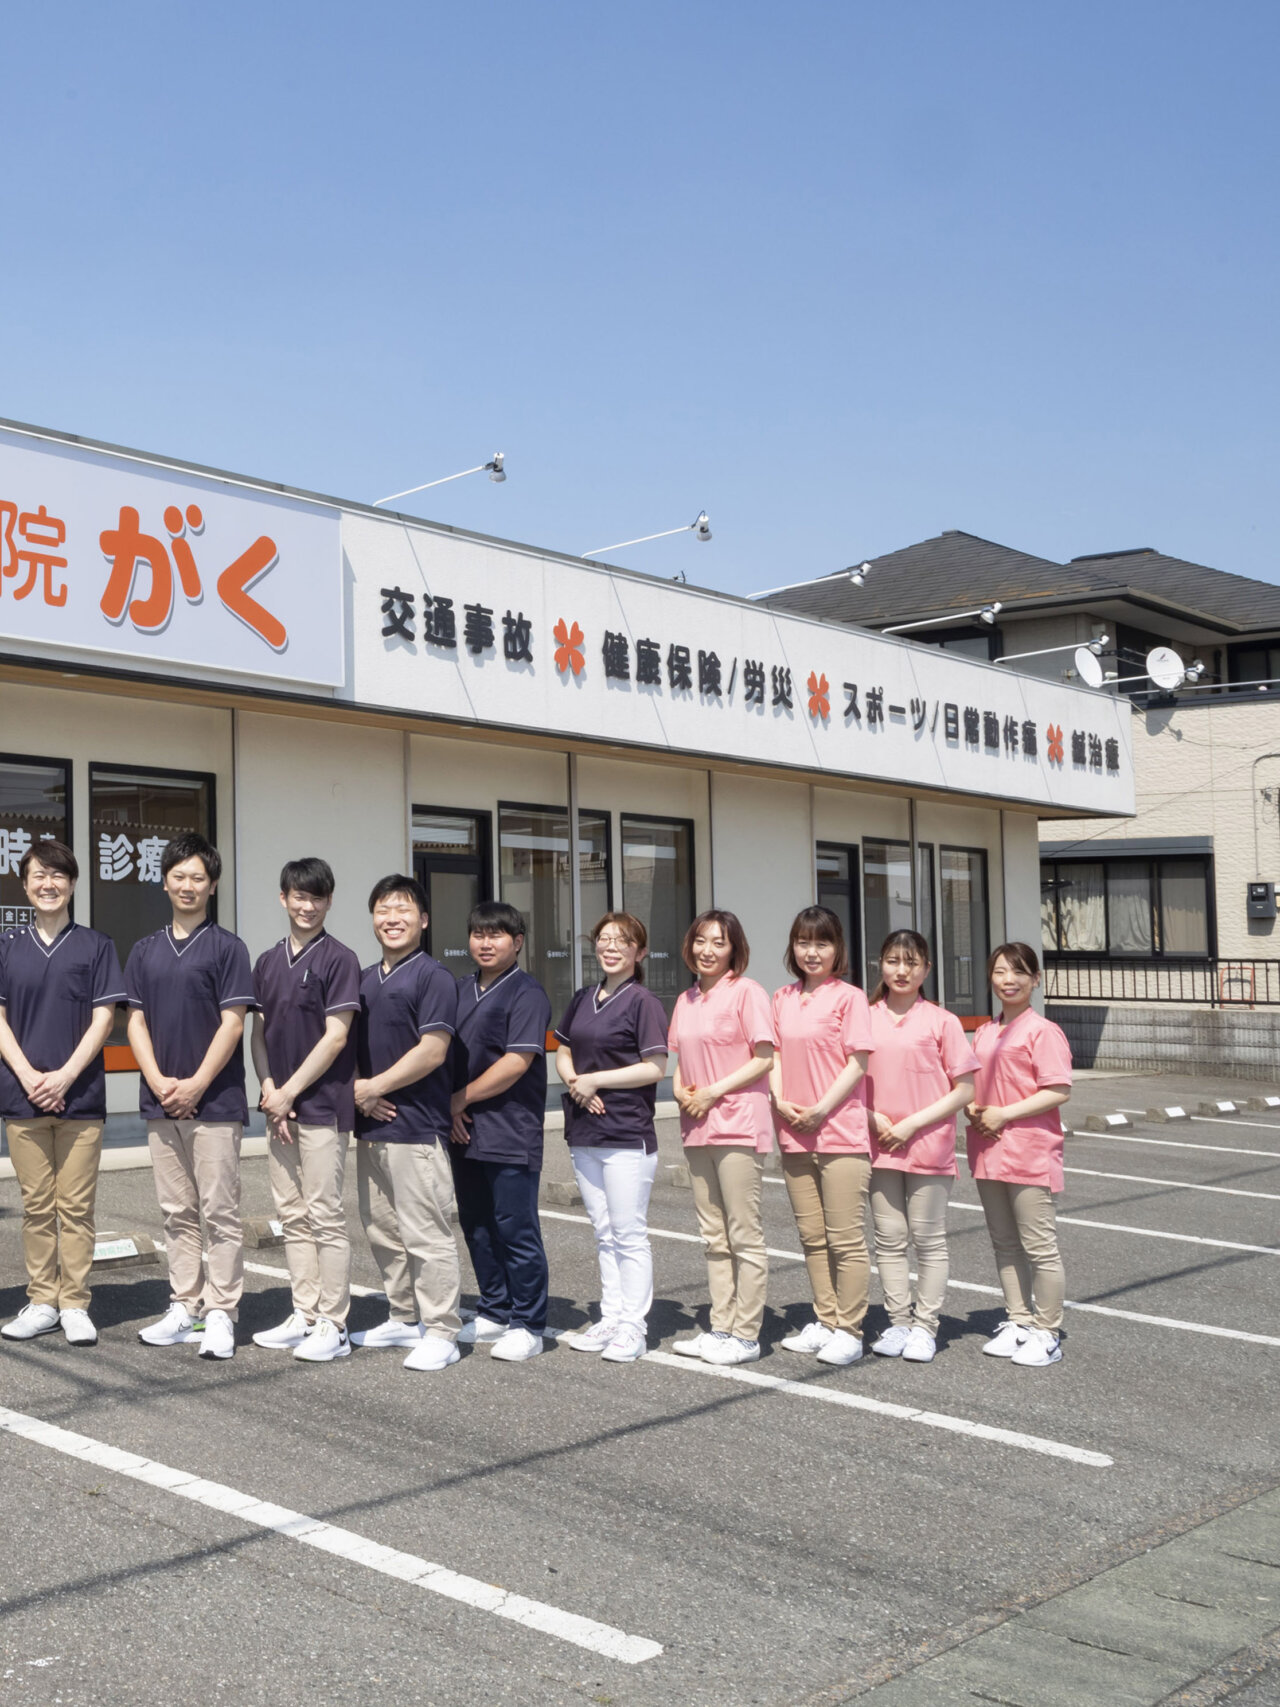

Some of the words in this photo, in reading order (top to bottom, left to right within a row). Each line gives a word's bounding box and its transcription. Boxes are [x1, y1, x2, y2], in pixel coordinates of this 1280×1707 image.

[99, 504, 288, 651] がく
[380, 586, 534, 663] 交通事故
